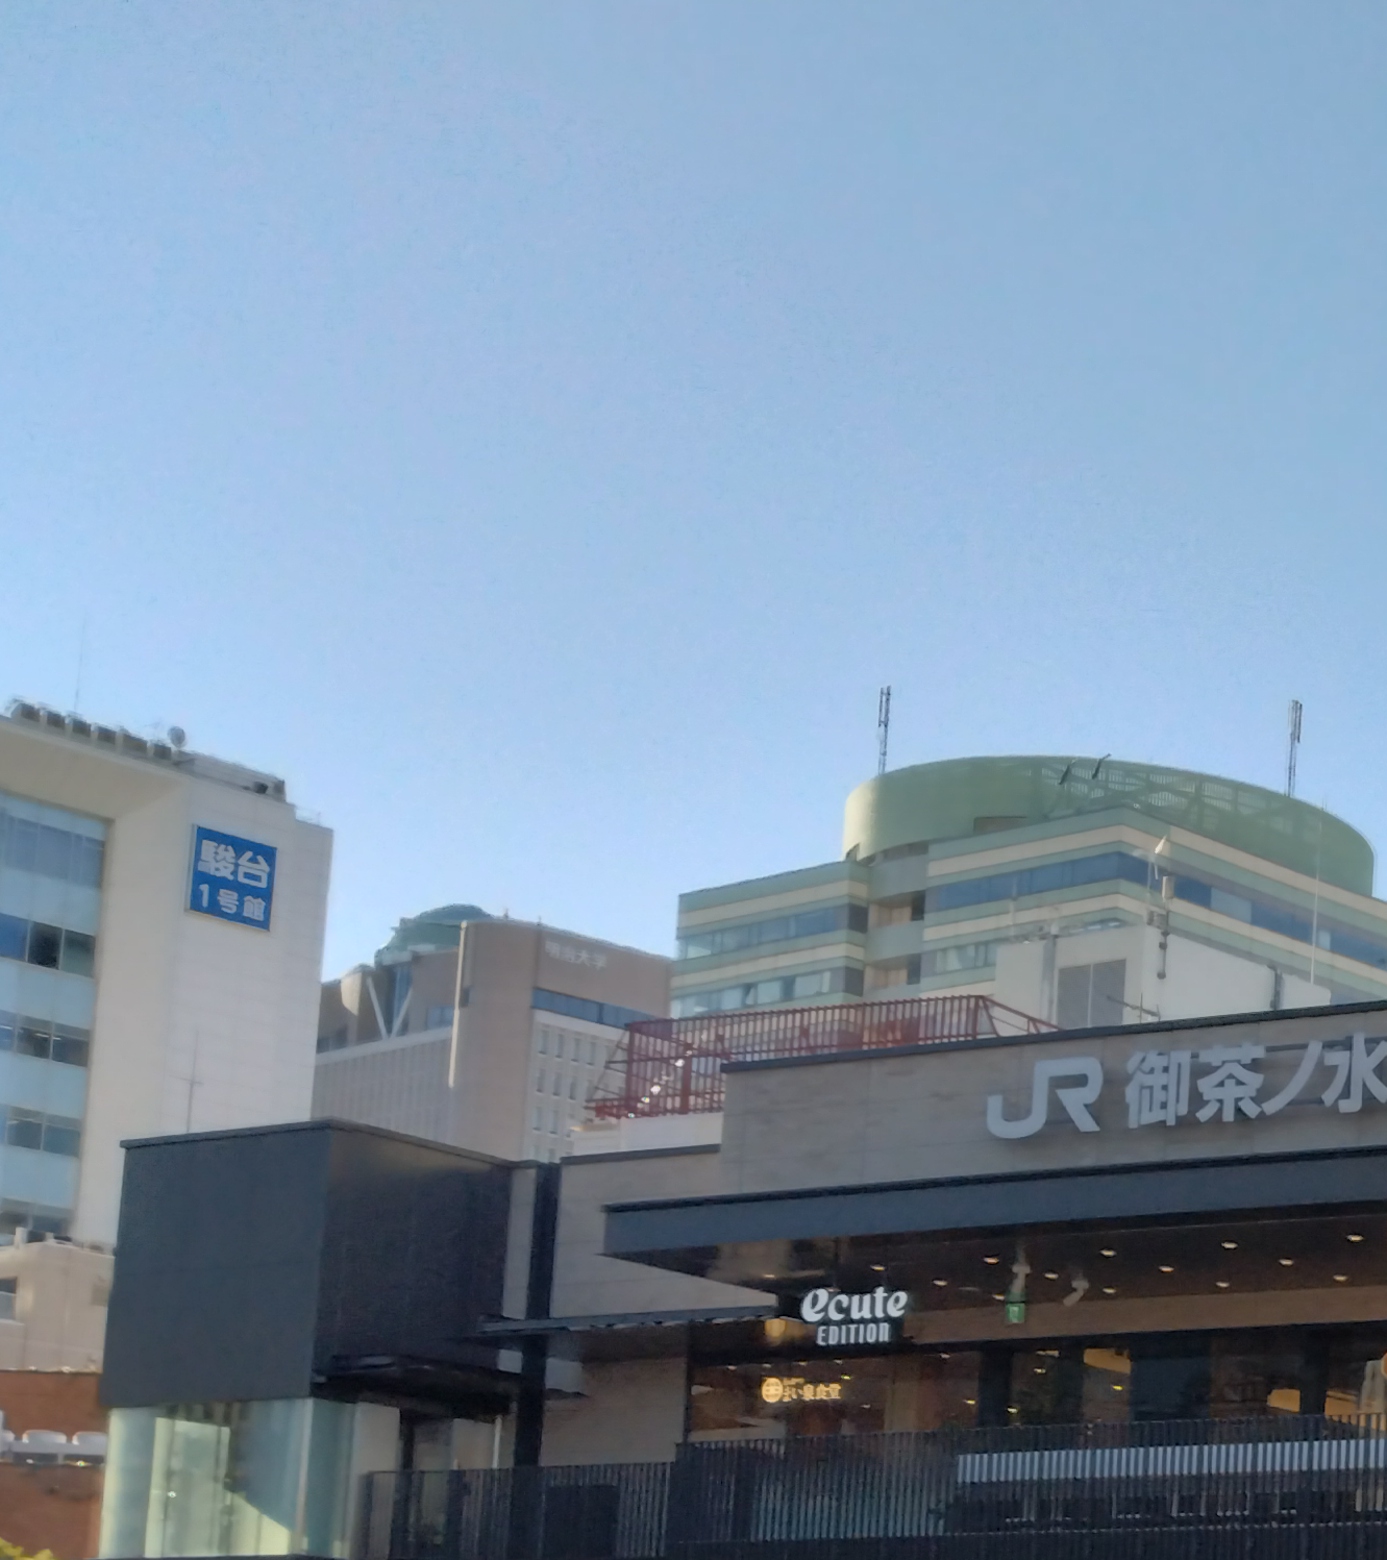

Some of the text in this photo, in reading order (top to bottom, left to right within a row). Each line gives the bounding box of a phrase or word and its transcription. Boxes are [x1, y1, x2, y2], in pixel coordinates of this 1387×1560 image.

[198, 839, 270, 888] 駿台
[199, 884, 266, 921] 1号館
[986, 1056, 1104, 1139] JR
[801, 1286, 908, 1322] ecute
[816, 1322, 890, 1346] EDITION
